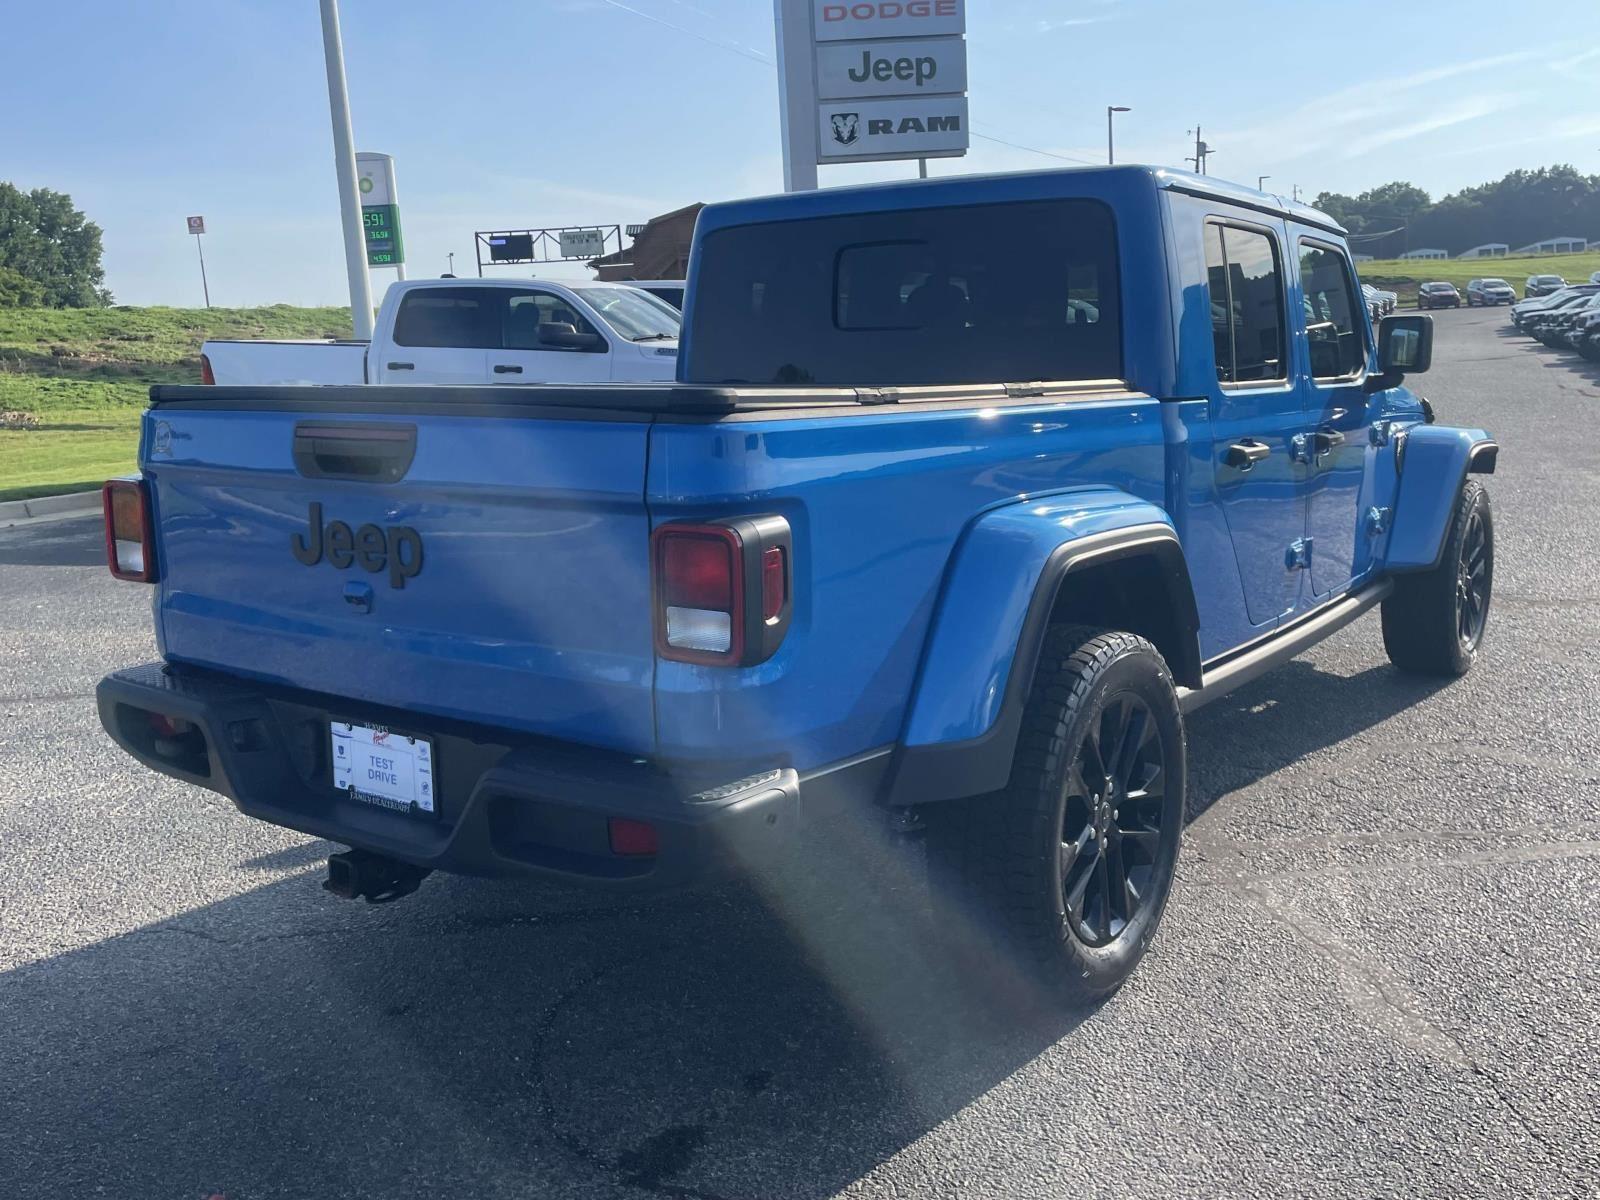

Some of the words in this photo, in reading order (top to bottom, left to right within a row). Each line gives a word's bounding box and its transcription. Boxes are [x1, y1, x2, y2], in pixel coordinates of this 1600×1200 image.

[824, 0, 957, 22] DODGE
[848, 51, 937, 86] Jeep
[868, 116, 960, 135] RAM
[290, 502, 424, 589] Jeep
[369, 756, 394, 771] TEST
[368, 769, 397, 785] DRIVE
